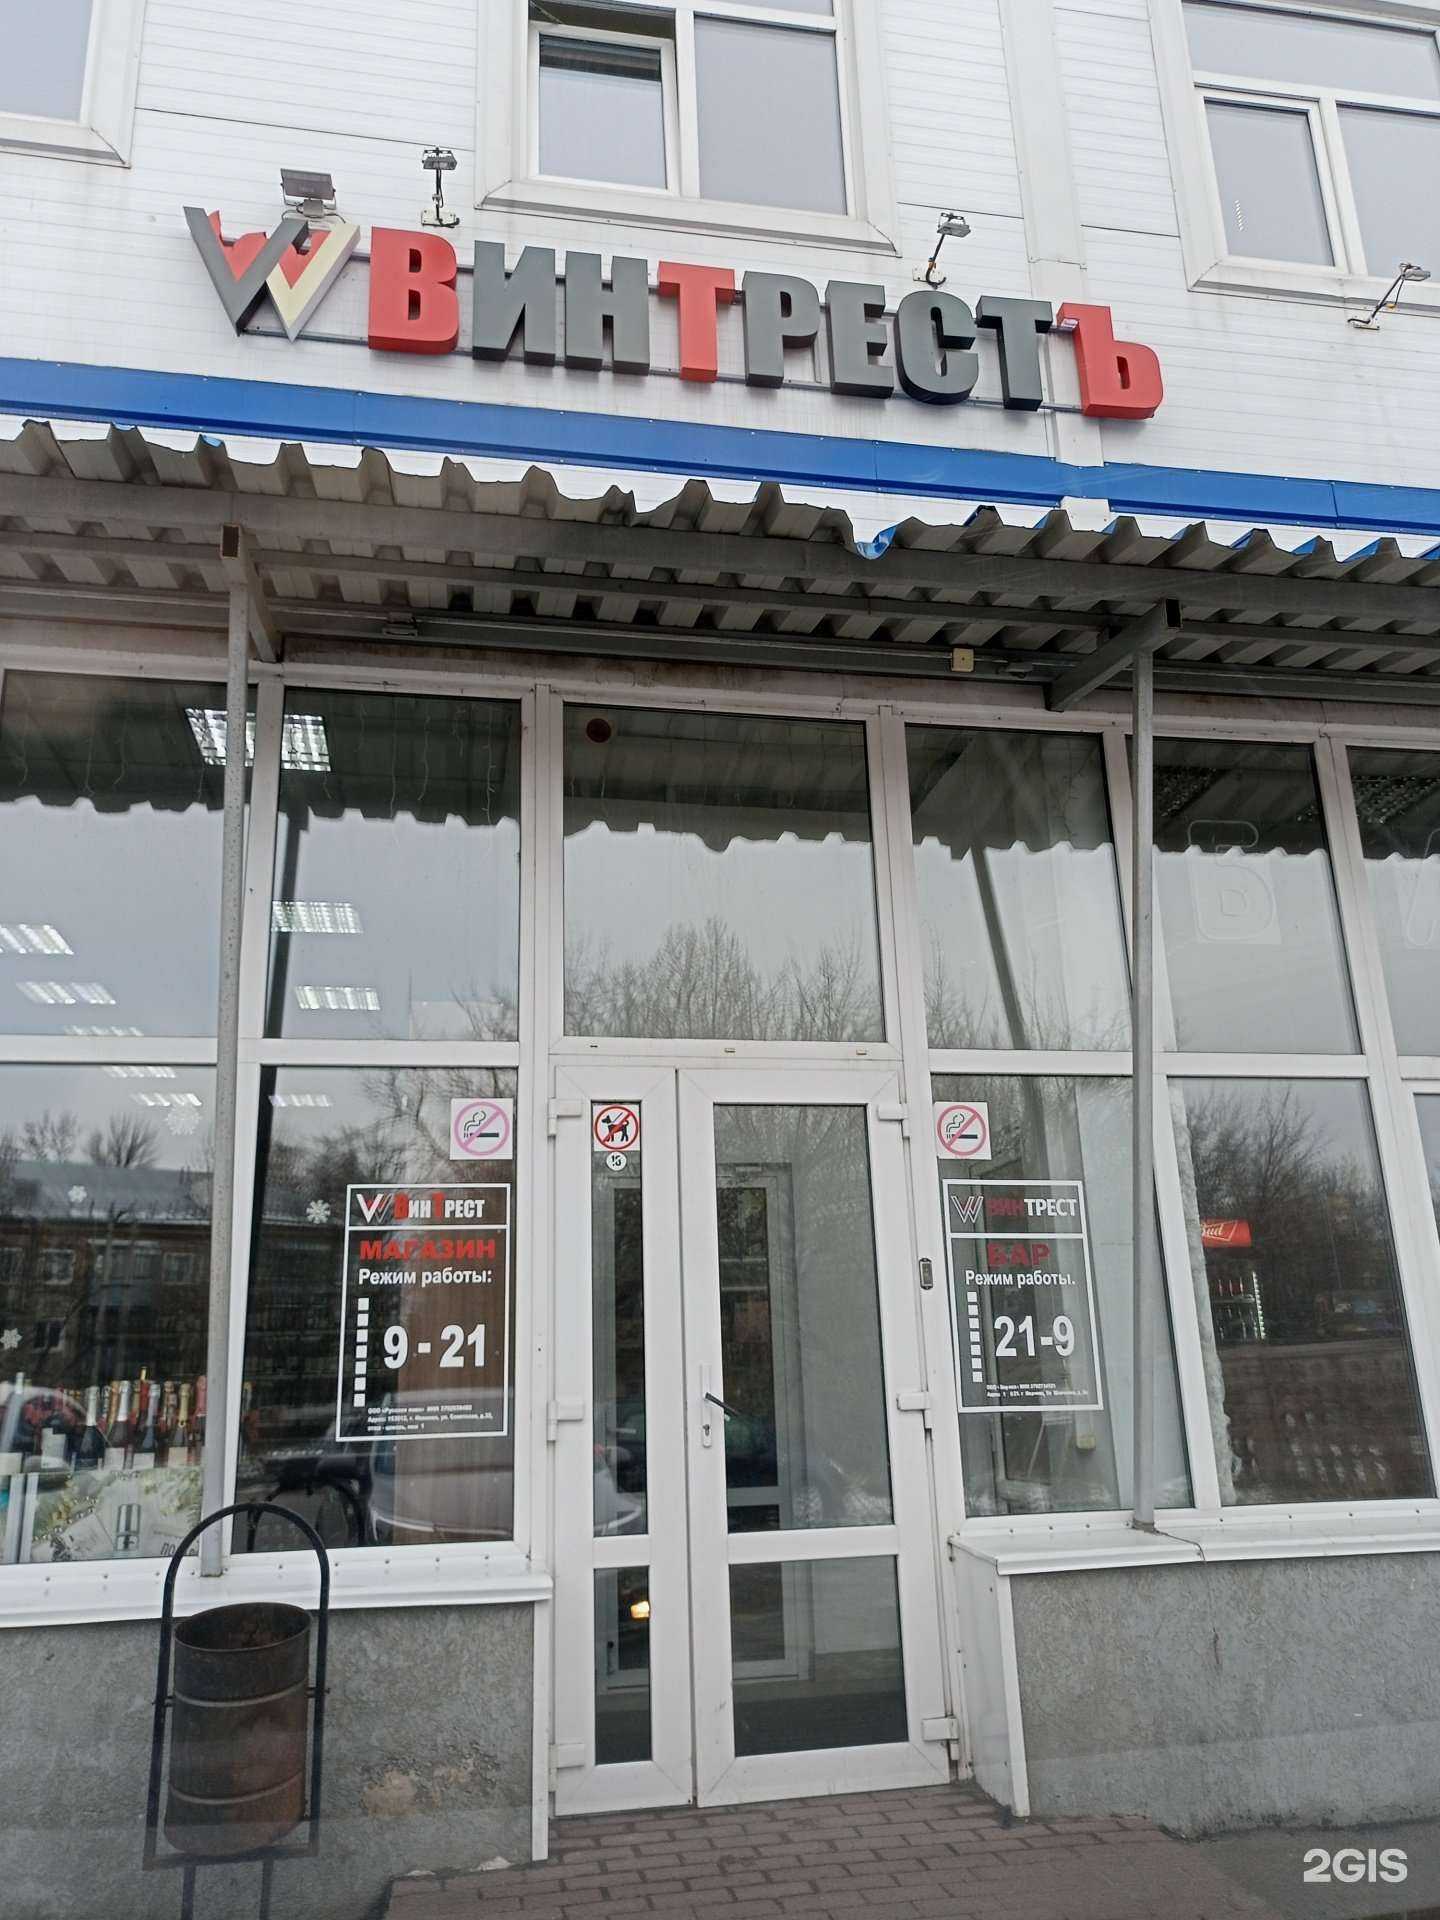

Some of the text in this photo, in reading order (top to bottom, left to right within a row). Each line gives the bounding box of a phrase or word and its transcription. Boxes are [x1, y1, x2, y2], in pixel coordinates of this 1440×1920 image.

[359, 1239, 496, 1261] МАГАЗИН
[986, 1242, 1051, 1267] БАР
[358, 1266, 493, 1288] Режим работы:
[965, 1269, 1014, 1286] Режим
[383, 1325, 409, 1370] 9
[439, 1324, 486, 1368] 21
[993, 1315, 1075, 1357] 21-9
